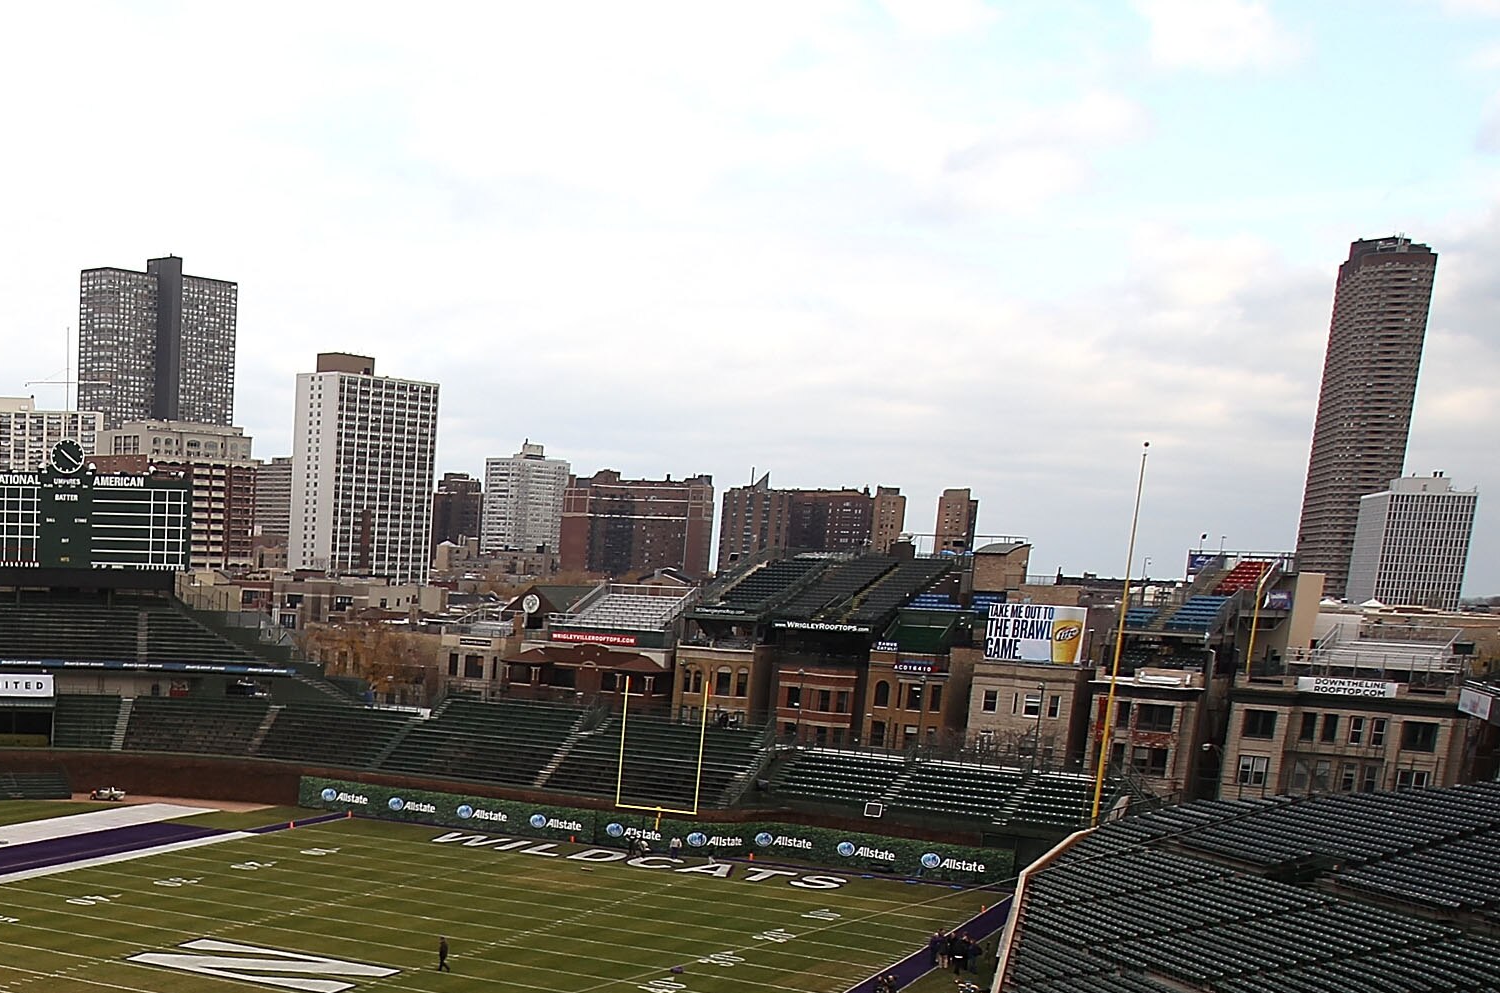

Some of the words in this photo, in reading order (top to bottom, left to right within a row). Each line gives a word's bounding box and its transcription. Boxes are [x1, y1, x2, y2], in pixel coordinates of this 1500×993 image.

[93, 476, 144, 487] AMERICAN
[54, 494, 78, 502] BATTER
[989, 603, 1009, 618] TAKE
[1011, 605, 1023, 618] ME
[1024, 606, 1042, 619] OUT
[1042, 607, 1054, 620] TO
[988, 618, 1009, 638] THE
[1011, 620, 1052, 640] BRAWL
[1057, 627, 1078, 642] Lite
[552, 632, 636, 645] WRIGLEYVILLEROOFTOPS.COM
[985, 638, 1022, 660] GAME.
[1313, 686, 1386, 697] ROOFTOP.COM
[336, 791, 368, 805] Allstate
[403, 801, 436, 814] Allstate
[472, 809, 507, 822] Allstate
[546, 817, 582, 831] Allstate
[706, 834, 742, 847] Allstate
[773, 835, 812, 849] Allstate
[431, 831, 847, 889] WILDCATS
[854, 845, 895, 861] Allstate
[940, 858, 985, 873] Allstate
